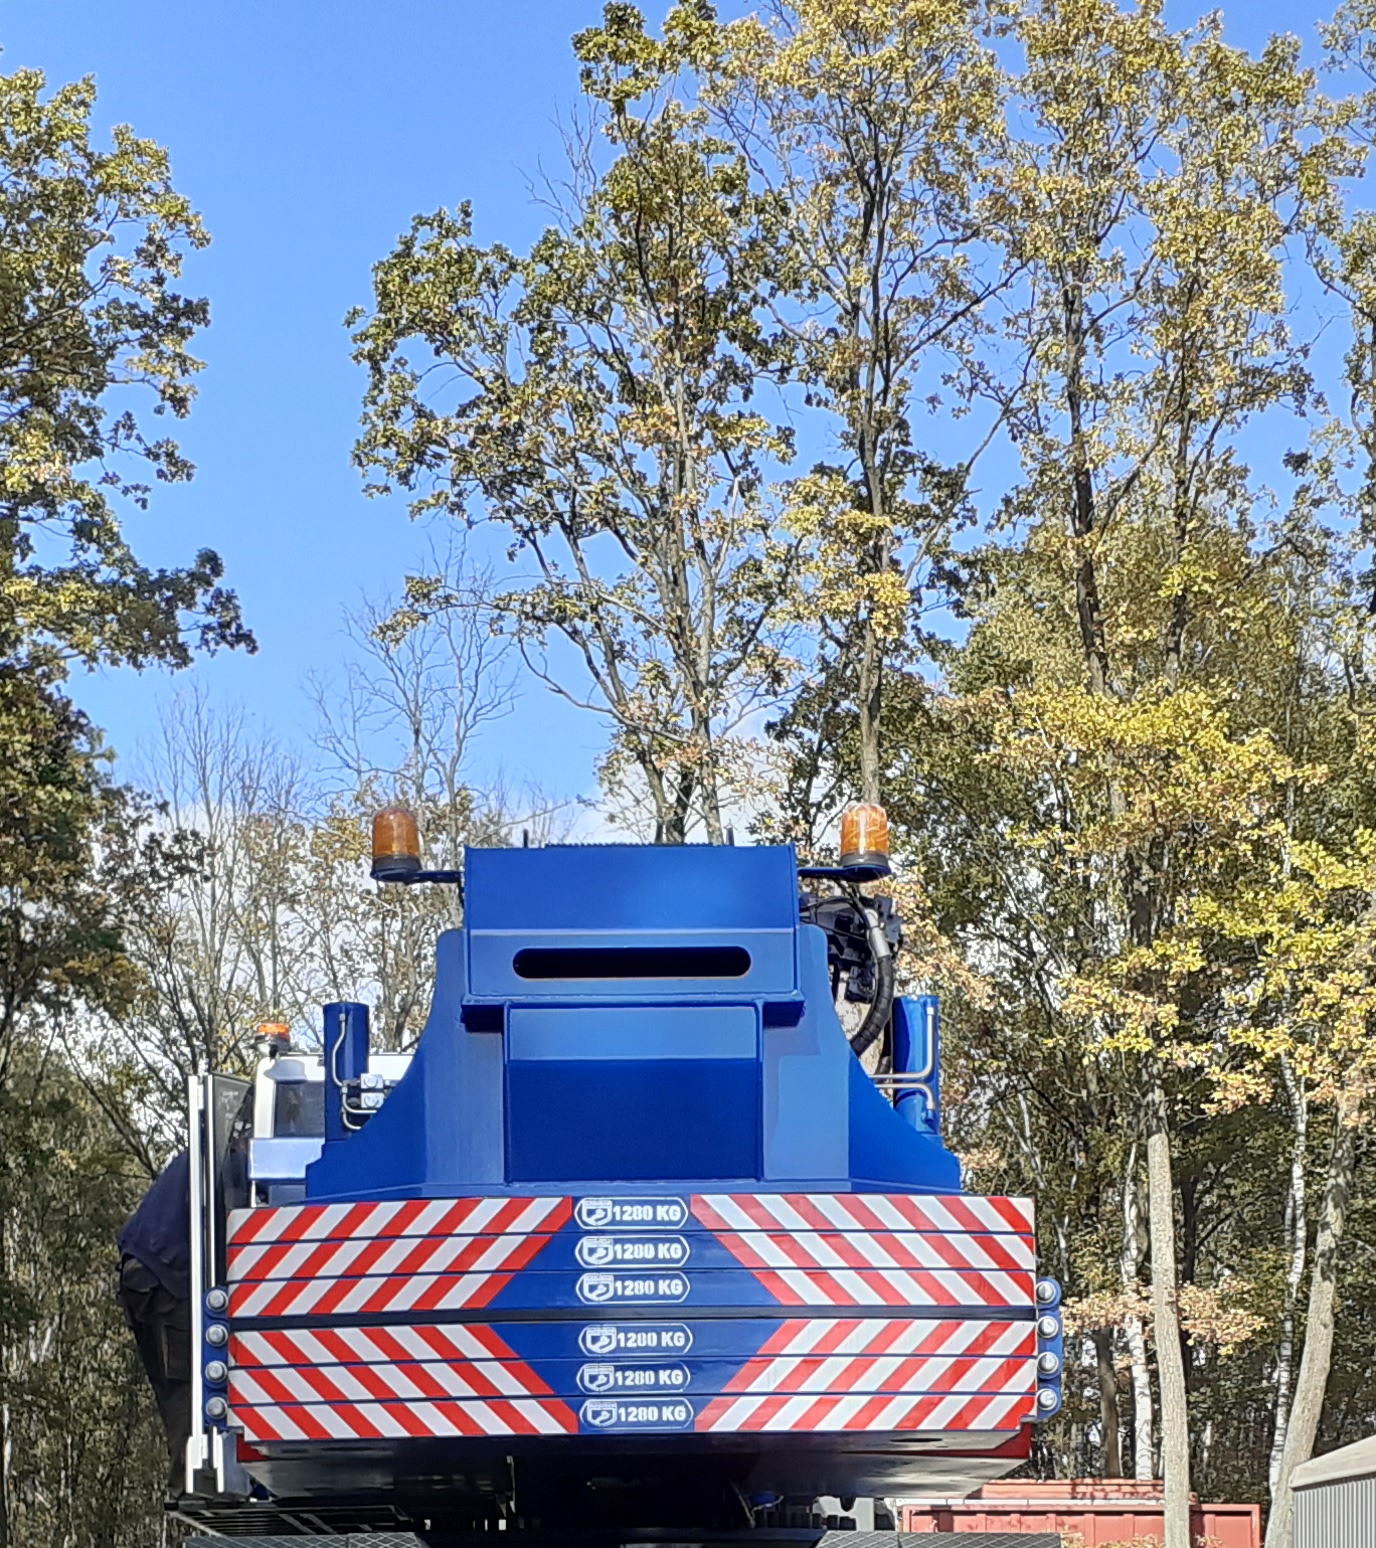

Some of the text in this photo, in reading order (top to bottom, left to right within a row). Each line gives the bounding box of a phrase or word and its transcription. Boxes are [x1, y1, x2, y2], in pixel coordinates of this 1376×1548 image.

[656, 1205, 682, 1221] KG
[658, 1243, 683, 1259] KG
[658, 1279, 684, 1296] KG
[661, 1331, 686, 1347] KG
[658, 1369, 684, 1385] KG
[662, 1405, 687, 1421] KG
